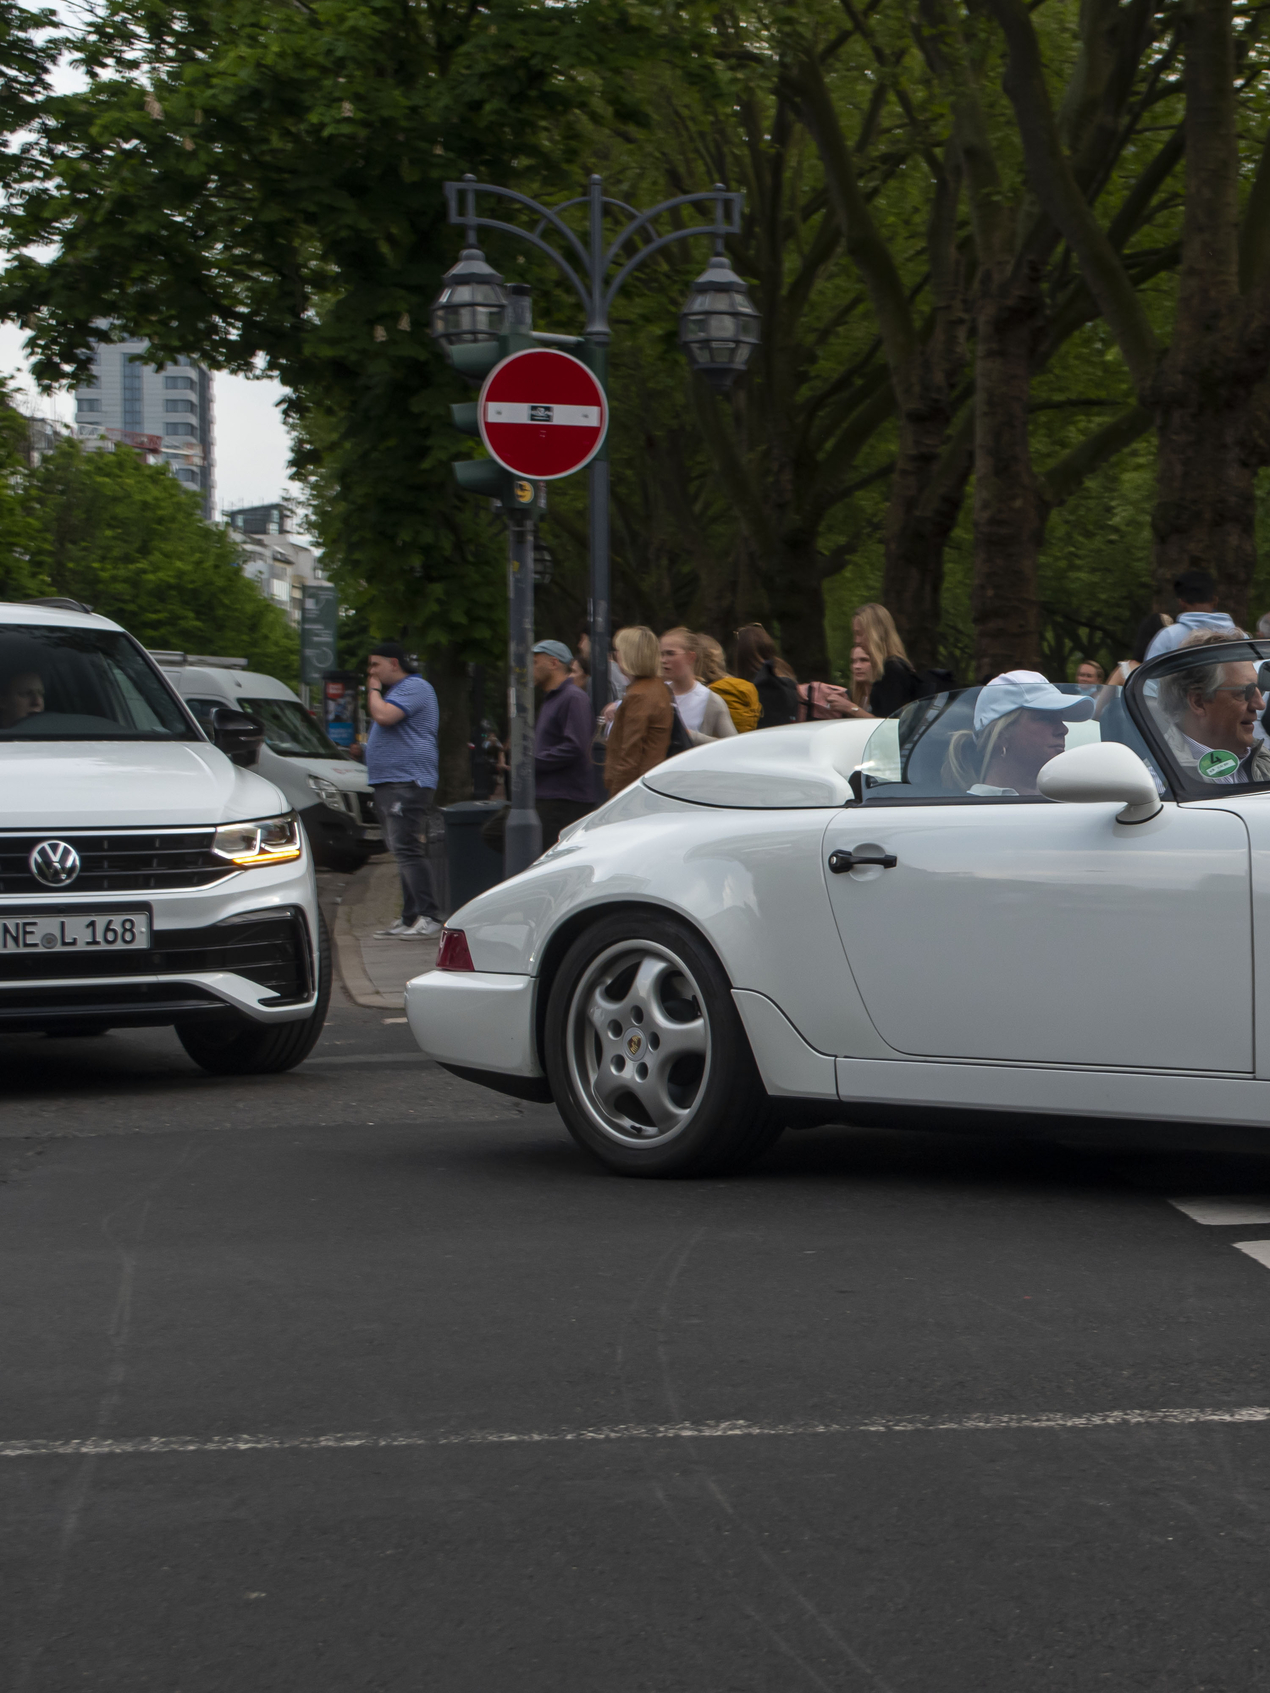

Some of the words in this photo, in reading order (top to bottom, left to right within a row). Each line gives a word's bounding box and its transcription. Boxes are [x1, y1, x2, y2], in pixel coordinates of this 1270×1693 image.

[2, 921, 40, 949] NE
[60, 920, 78, 947] L
[85, 918, 137, 946] 168
